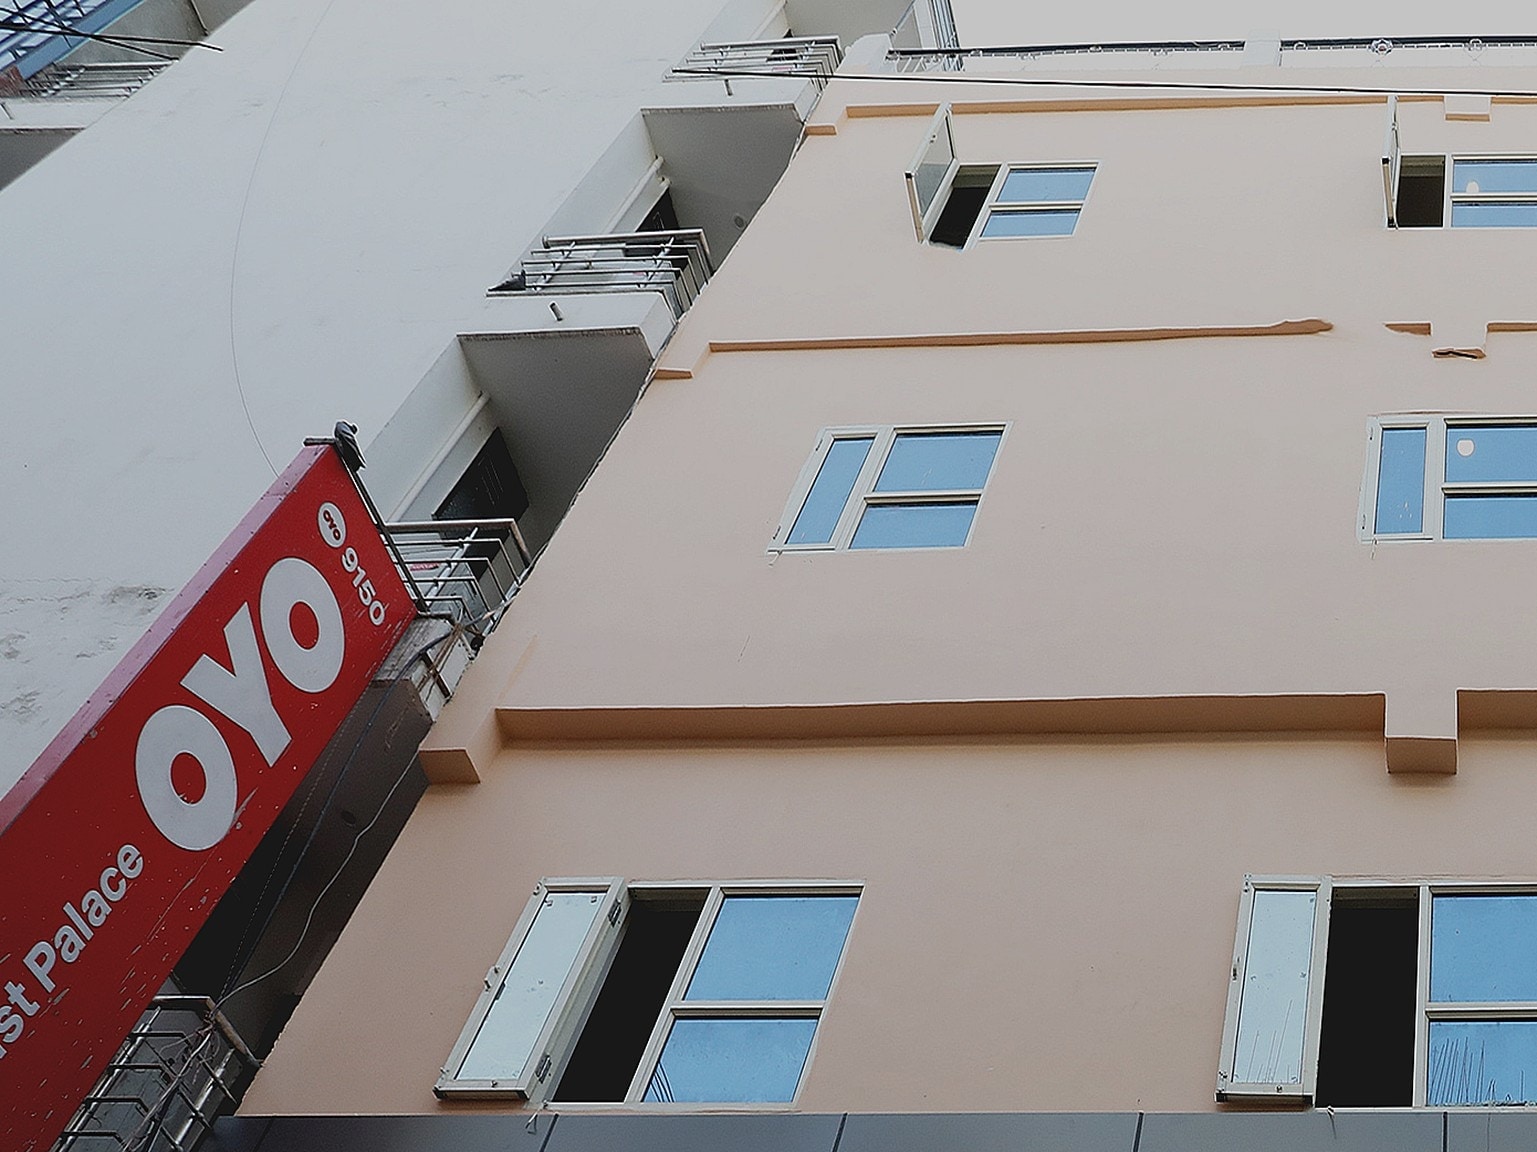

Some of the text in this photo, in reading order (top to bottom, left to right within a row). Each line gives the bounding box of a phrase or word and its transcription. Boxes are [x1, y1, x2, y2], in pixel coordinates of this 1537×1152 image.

[322, 509, 386, 626] OYO 9150
[134, 556, 345, 852] OYO
[0, 844, 144, 1060] st Palace
